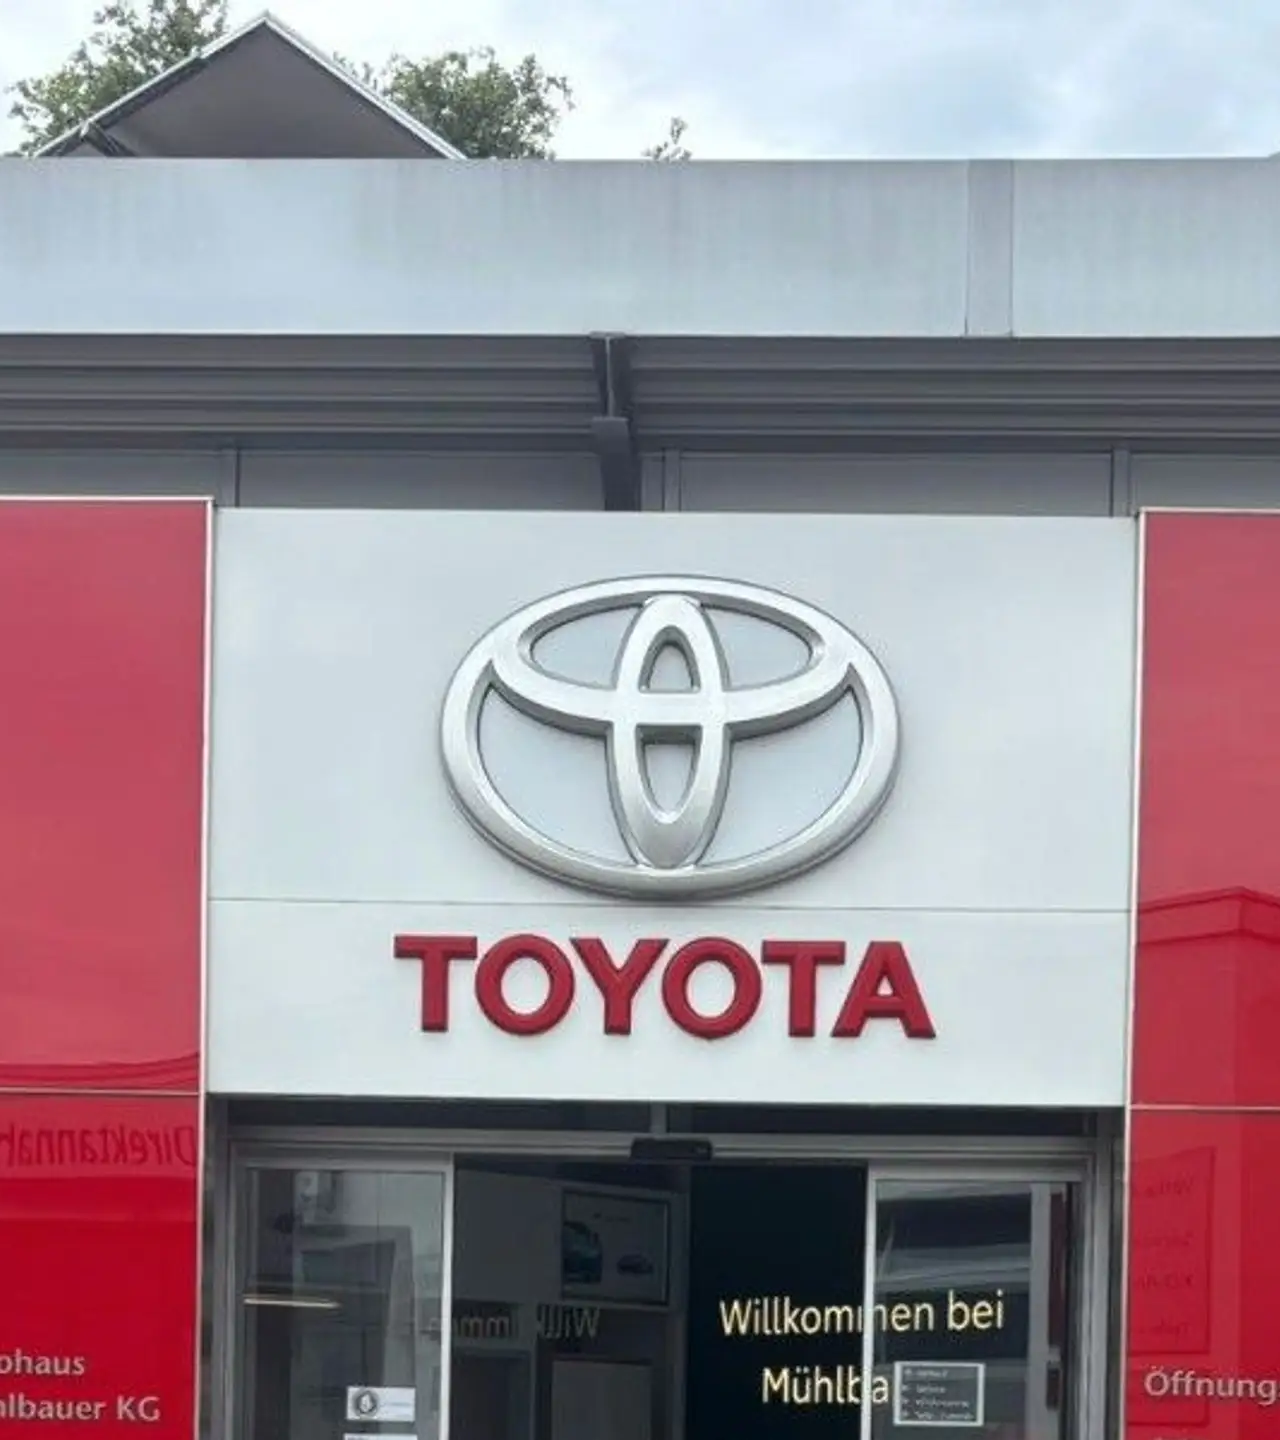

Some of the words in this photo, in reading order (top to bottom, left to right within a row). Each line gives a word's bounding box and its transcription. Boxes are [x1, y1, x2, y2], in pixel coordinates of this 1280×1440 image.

[393, 933, 937, 1040] TOYOTA
[720, 1295, 935, 1335] Willkommen
[947, 1289, 1004, 1331] bei
[116, 1398, 161, 1423] KG
